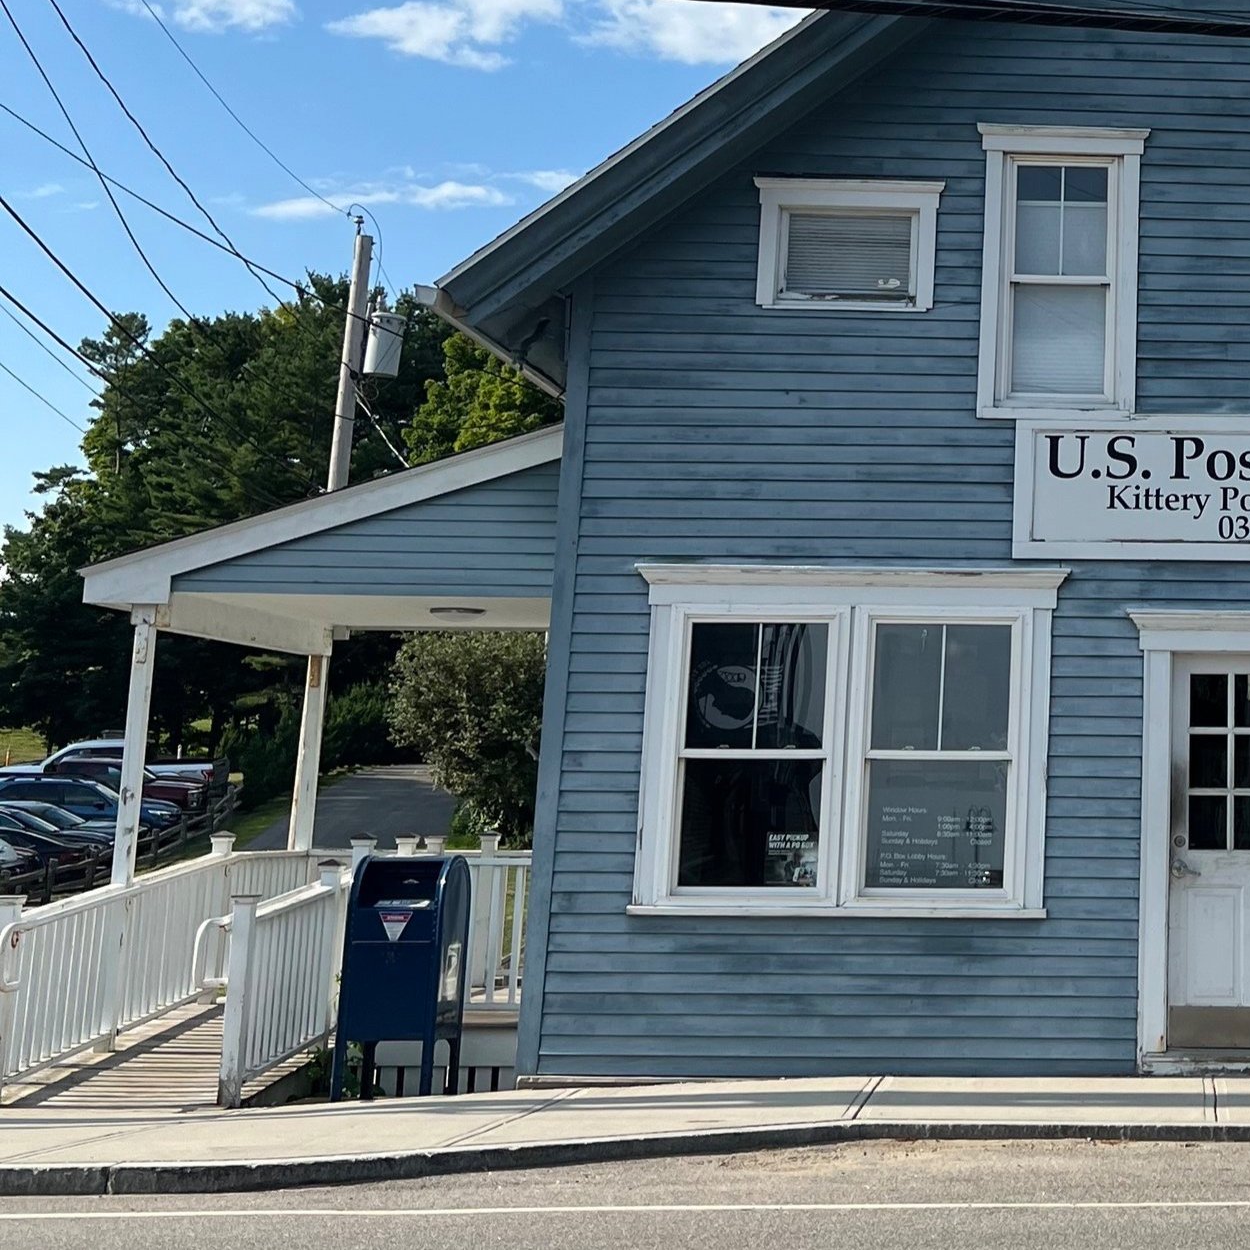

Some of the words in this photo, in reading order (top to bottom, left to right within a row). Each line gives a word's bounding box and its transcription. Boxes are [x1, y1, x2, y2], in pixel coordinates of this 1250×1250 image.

[1045, 435, 1151, 480] U.S.
[1106, 485, 1211, 520] Kittery
[768, 841, 785, 849] WITH
[785, 841, 791, 849] A
